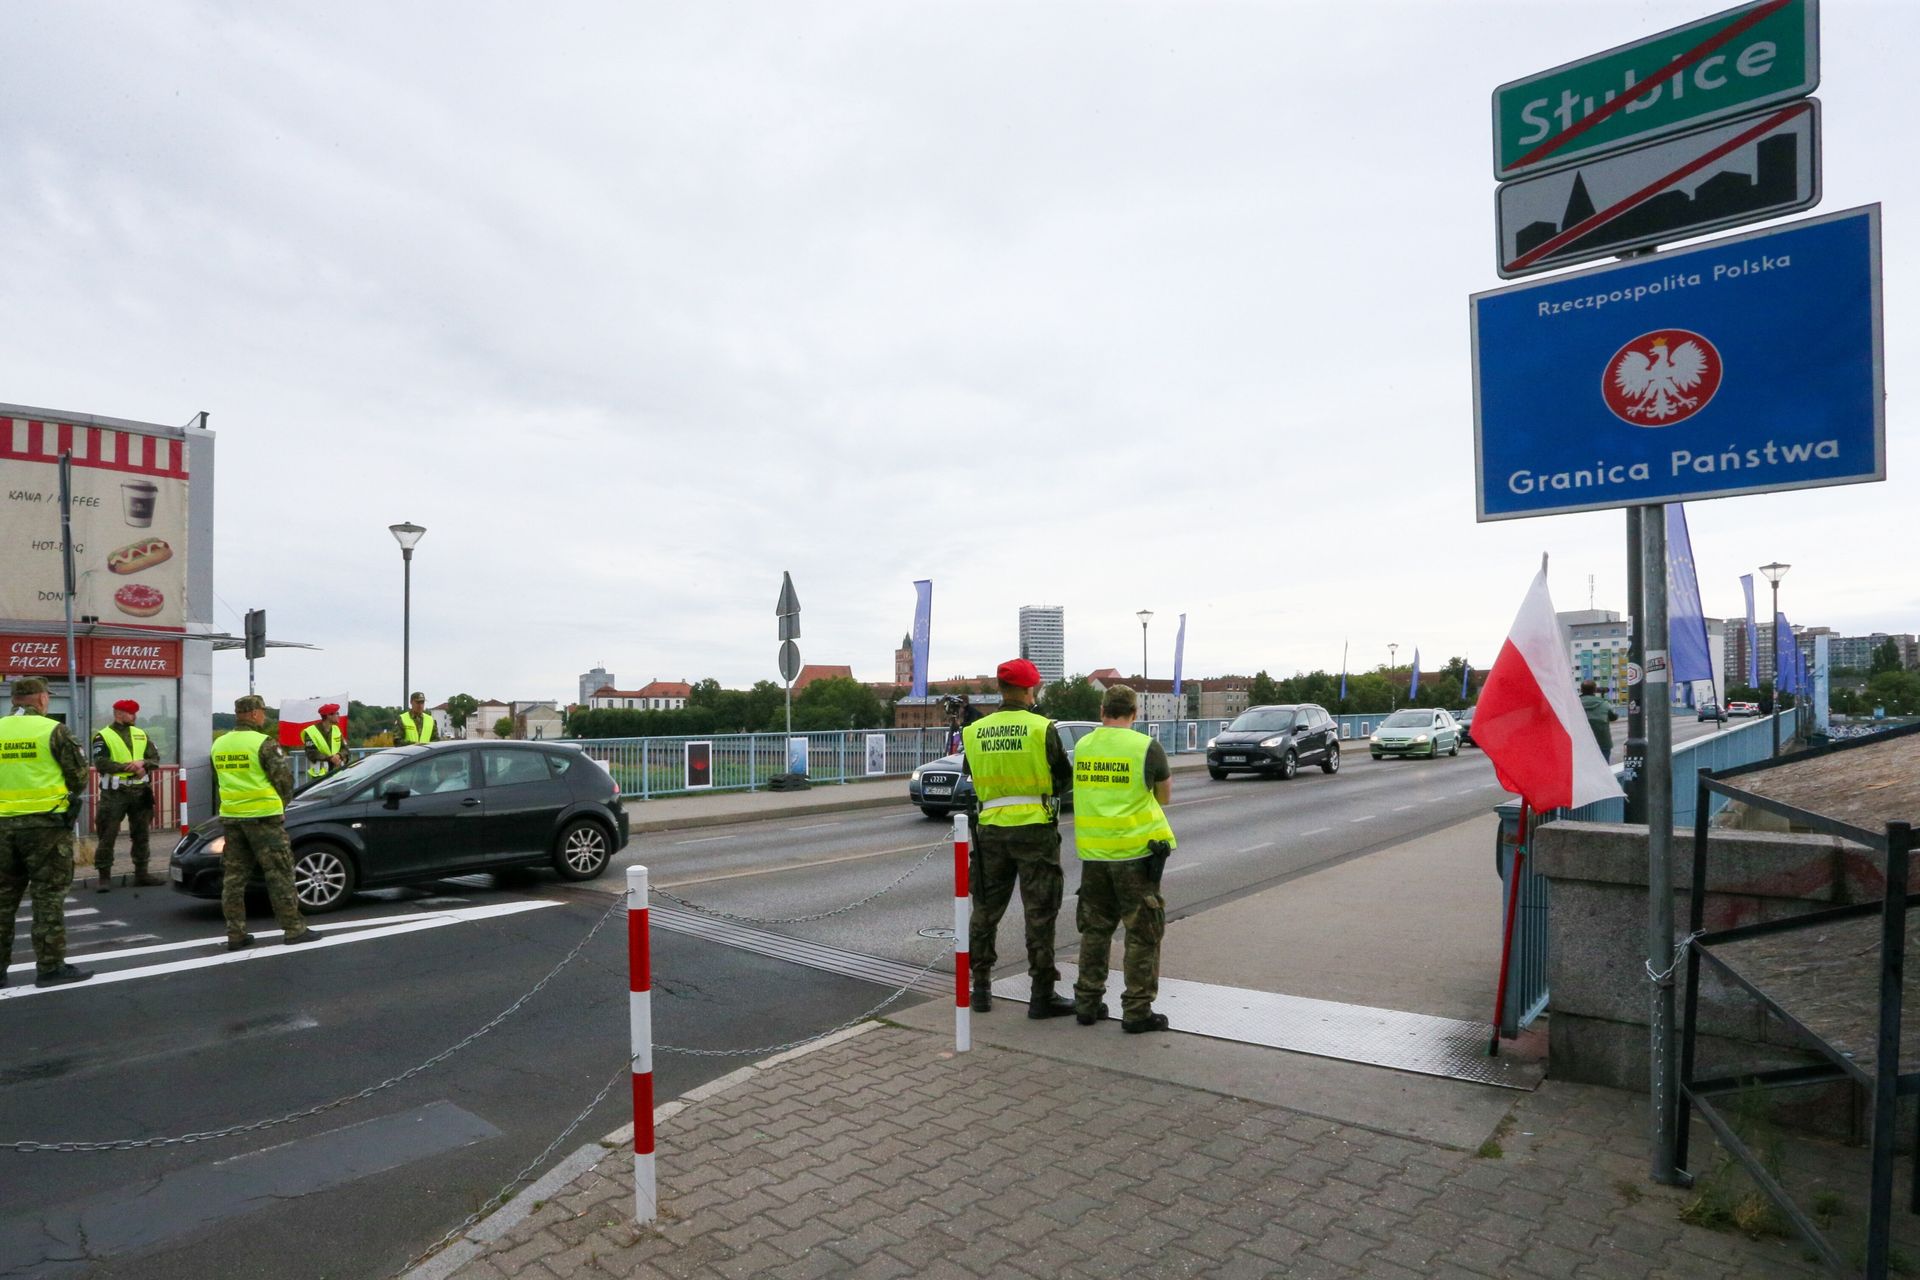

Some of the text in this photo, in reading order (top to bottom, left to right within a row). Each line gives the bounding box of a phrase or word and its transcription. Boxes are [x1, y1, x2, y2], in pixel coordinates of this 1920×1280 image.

[1518, 41, 1777, 146] Słubice
[1538, 253, 1792, 317] Rzeczpospolita Polska
[1508, 438, 1840, 495] Granica Państwa
[8, 490, 42, 503] KAWA
[57, 495, 100, 508] FFEE
[31, 540, 84, 554] HOT-DG
[38, 591, 78, 601] DONT
[11, 642, 60, 654] CIEPŁE
[111, 645, 161, 657] WARME
[9, 655, 61, 669] PĄCZKI
[104, 658, 167, 670] BERLINER
[976, 724, 1028, 739] ŻANDARMERIA
[981, 738, 1023, 752] WOJSKOWA
[1093, 761, 1130, 773] GRANICZNA
[1090, 775, 1110, 783] BORDER
[1112, 775, 1130, 784] GUARD
